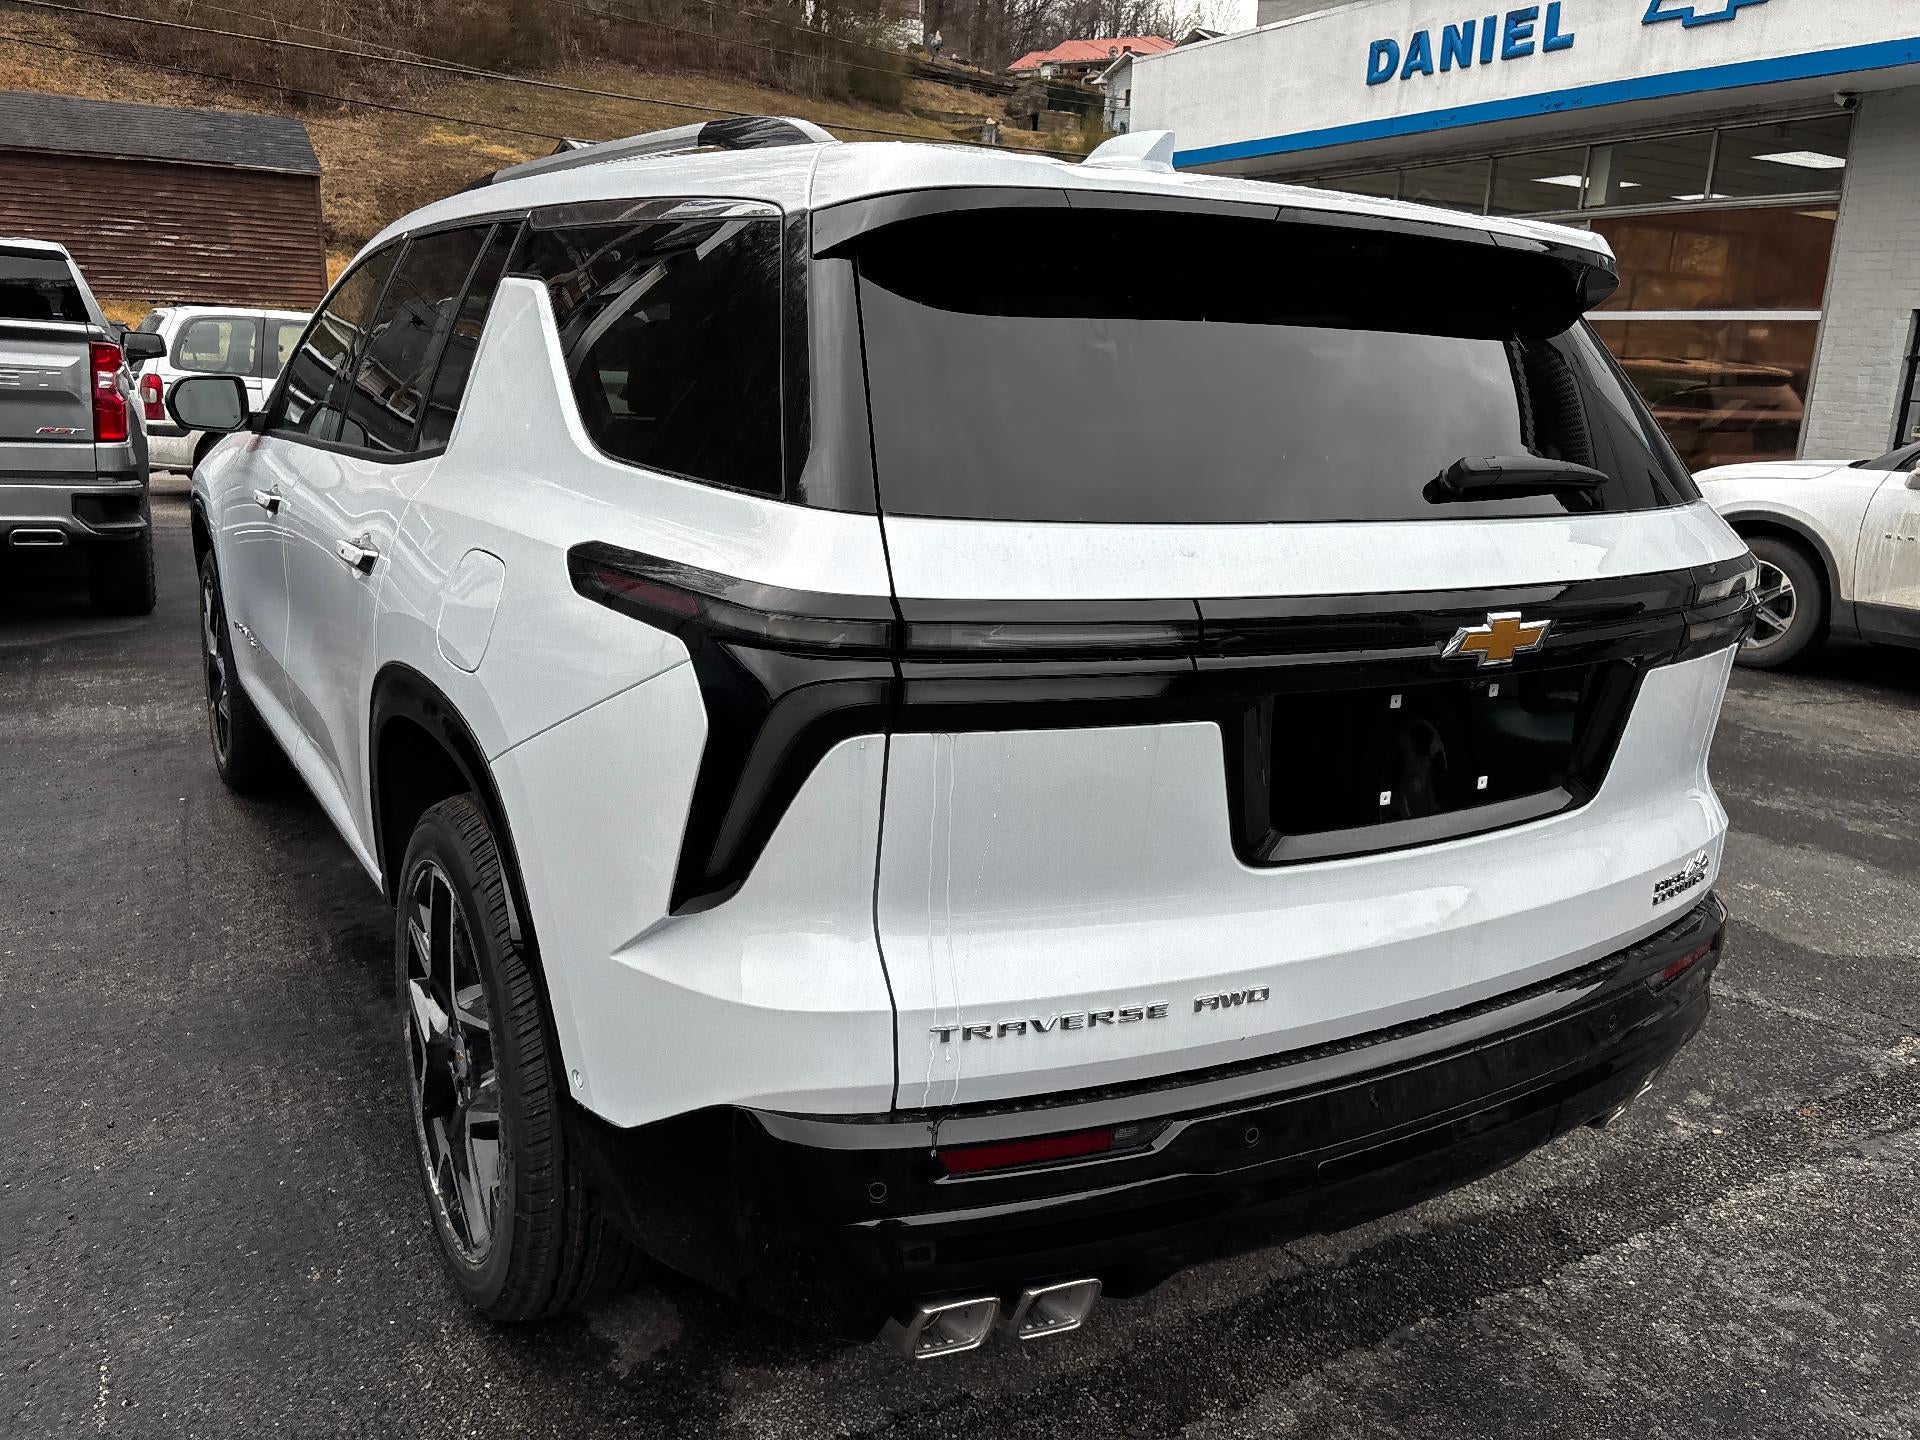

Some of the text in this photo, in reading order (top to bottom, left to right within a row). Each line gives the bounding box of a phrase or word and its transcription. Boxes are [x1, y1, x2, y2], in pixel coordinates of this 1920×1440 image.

[1366, 1, 1575, 86] DANIEL
[929, 984, 1270, 1043] TRAVERSE AWD
